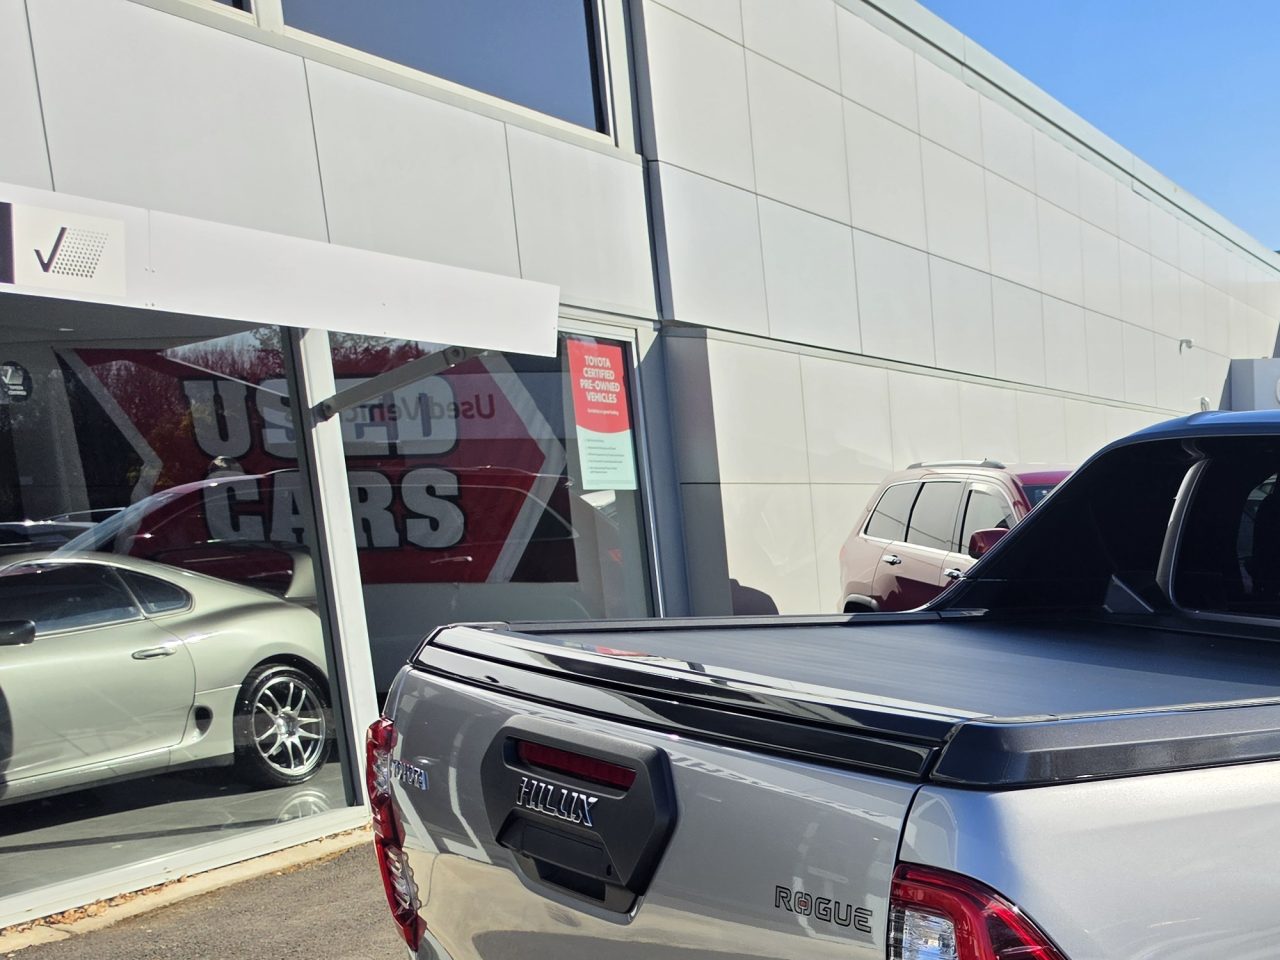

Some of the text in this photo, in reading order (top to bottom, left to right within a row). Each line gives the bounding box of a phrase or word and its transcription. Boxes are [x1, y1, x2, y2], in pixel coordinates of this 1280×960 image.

[584, 355, 611, 368] TOYOTA
[583, 367, 615, 380] CERTIFIED
[580, 379, 620, 392] PRE-OWNED
[586, 391, 617, 404] VEHICLES
[517, 776, 599, 828] HILUX
[774, 885, 873, 934] ROGUE
